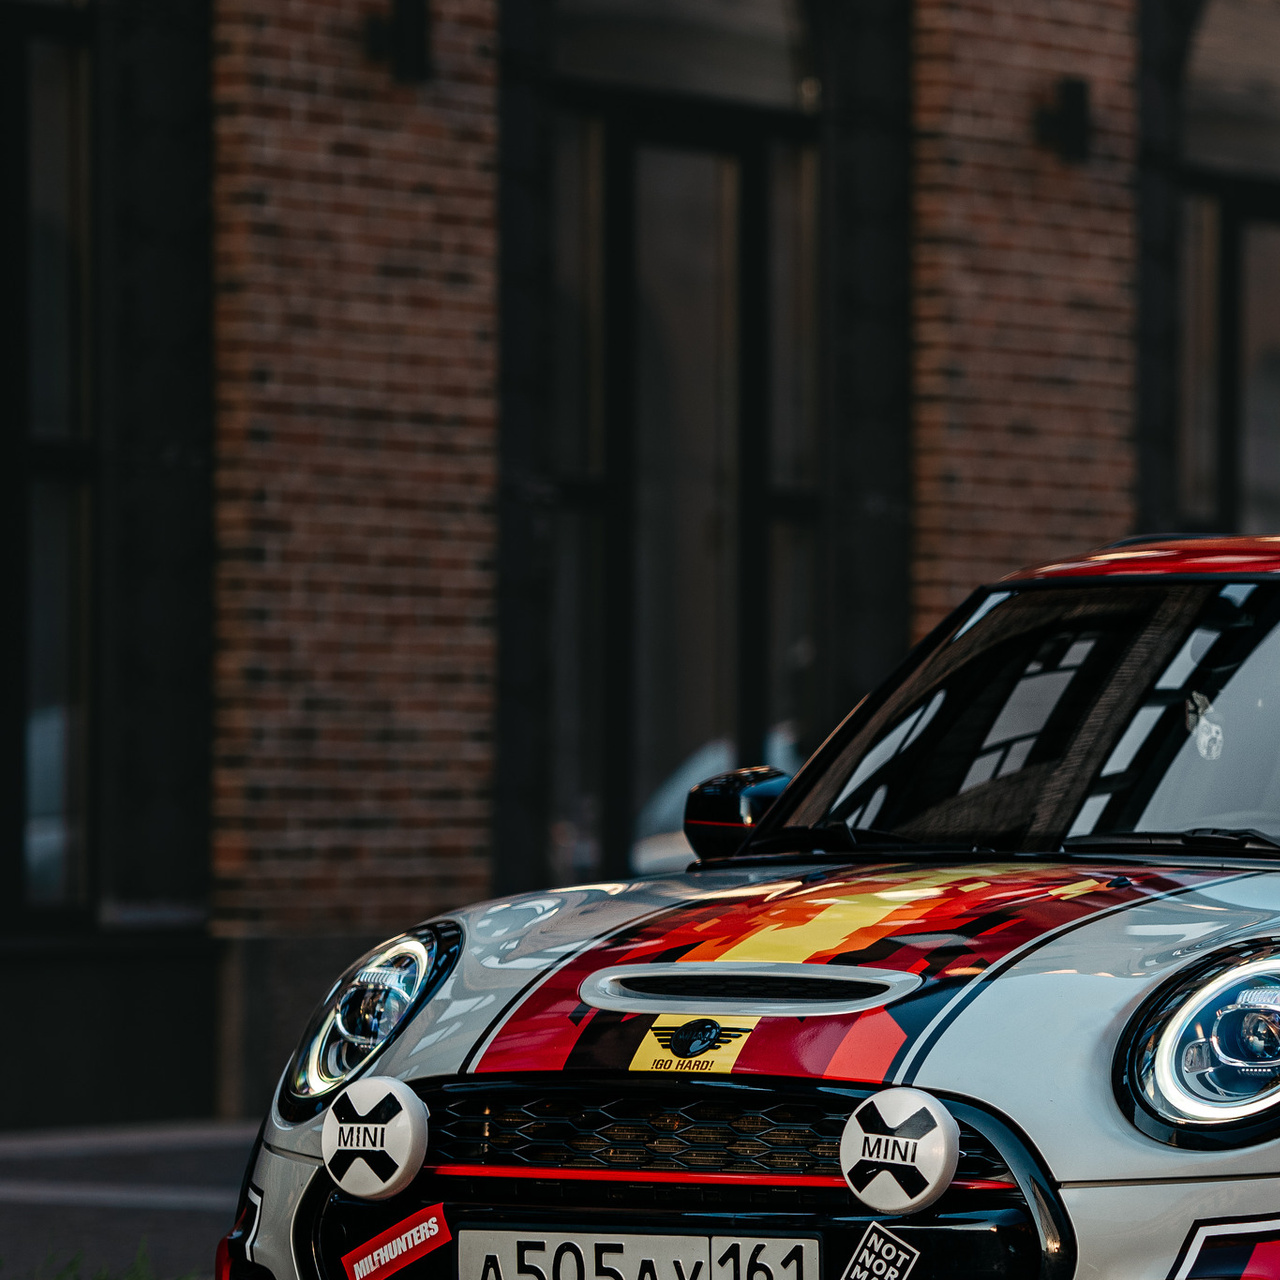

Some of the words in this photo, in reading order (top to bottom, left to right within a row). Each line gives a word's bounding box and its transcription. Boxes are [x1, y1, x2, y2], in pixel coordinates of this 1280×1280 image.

[651, 1059, 673, 1070] !GO
[675, 1060, 715, 1071] HARD!
[338, 1126, 385, 1148] MINI
[862, 1136, 918, 1163] MINI
[353, 1217, 439, 1280] MILFHUNTERS
[867, 1232, 910, 1268] NOT
